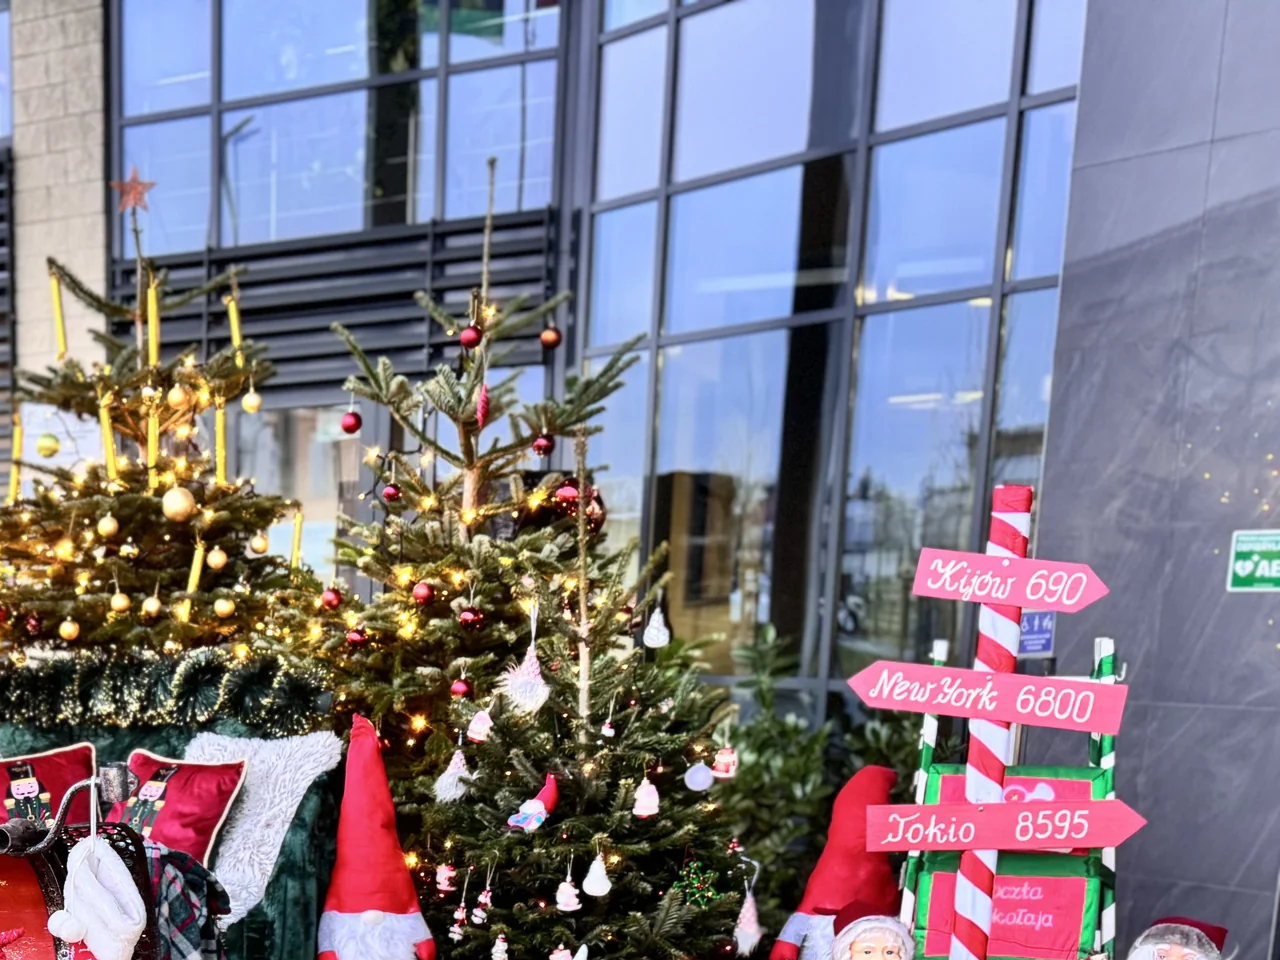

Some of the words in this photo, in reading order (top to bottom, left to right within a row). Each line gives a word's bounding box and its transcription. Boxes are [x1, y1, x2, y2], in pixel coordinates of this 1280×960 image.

[926, 558, 1017, 602] Kijów
[1025, 569, 1089, 605] 690
[869, 669, 937, 703] New
[933, 676, 999, 712] York
[1015, 685, 1096, 723] 6800
[880, 812, 976, 845] Tokio
[1014, 809, 1090, 843] 8595
